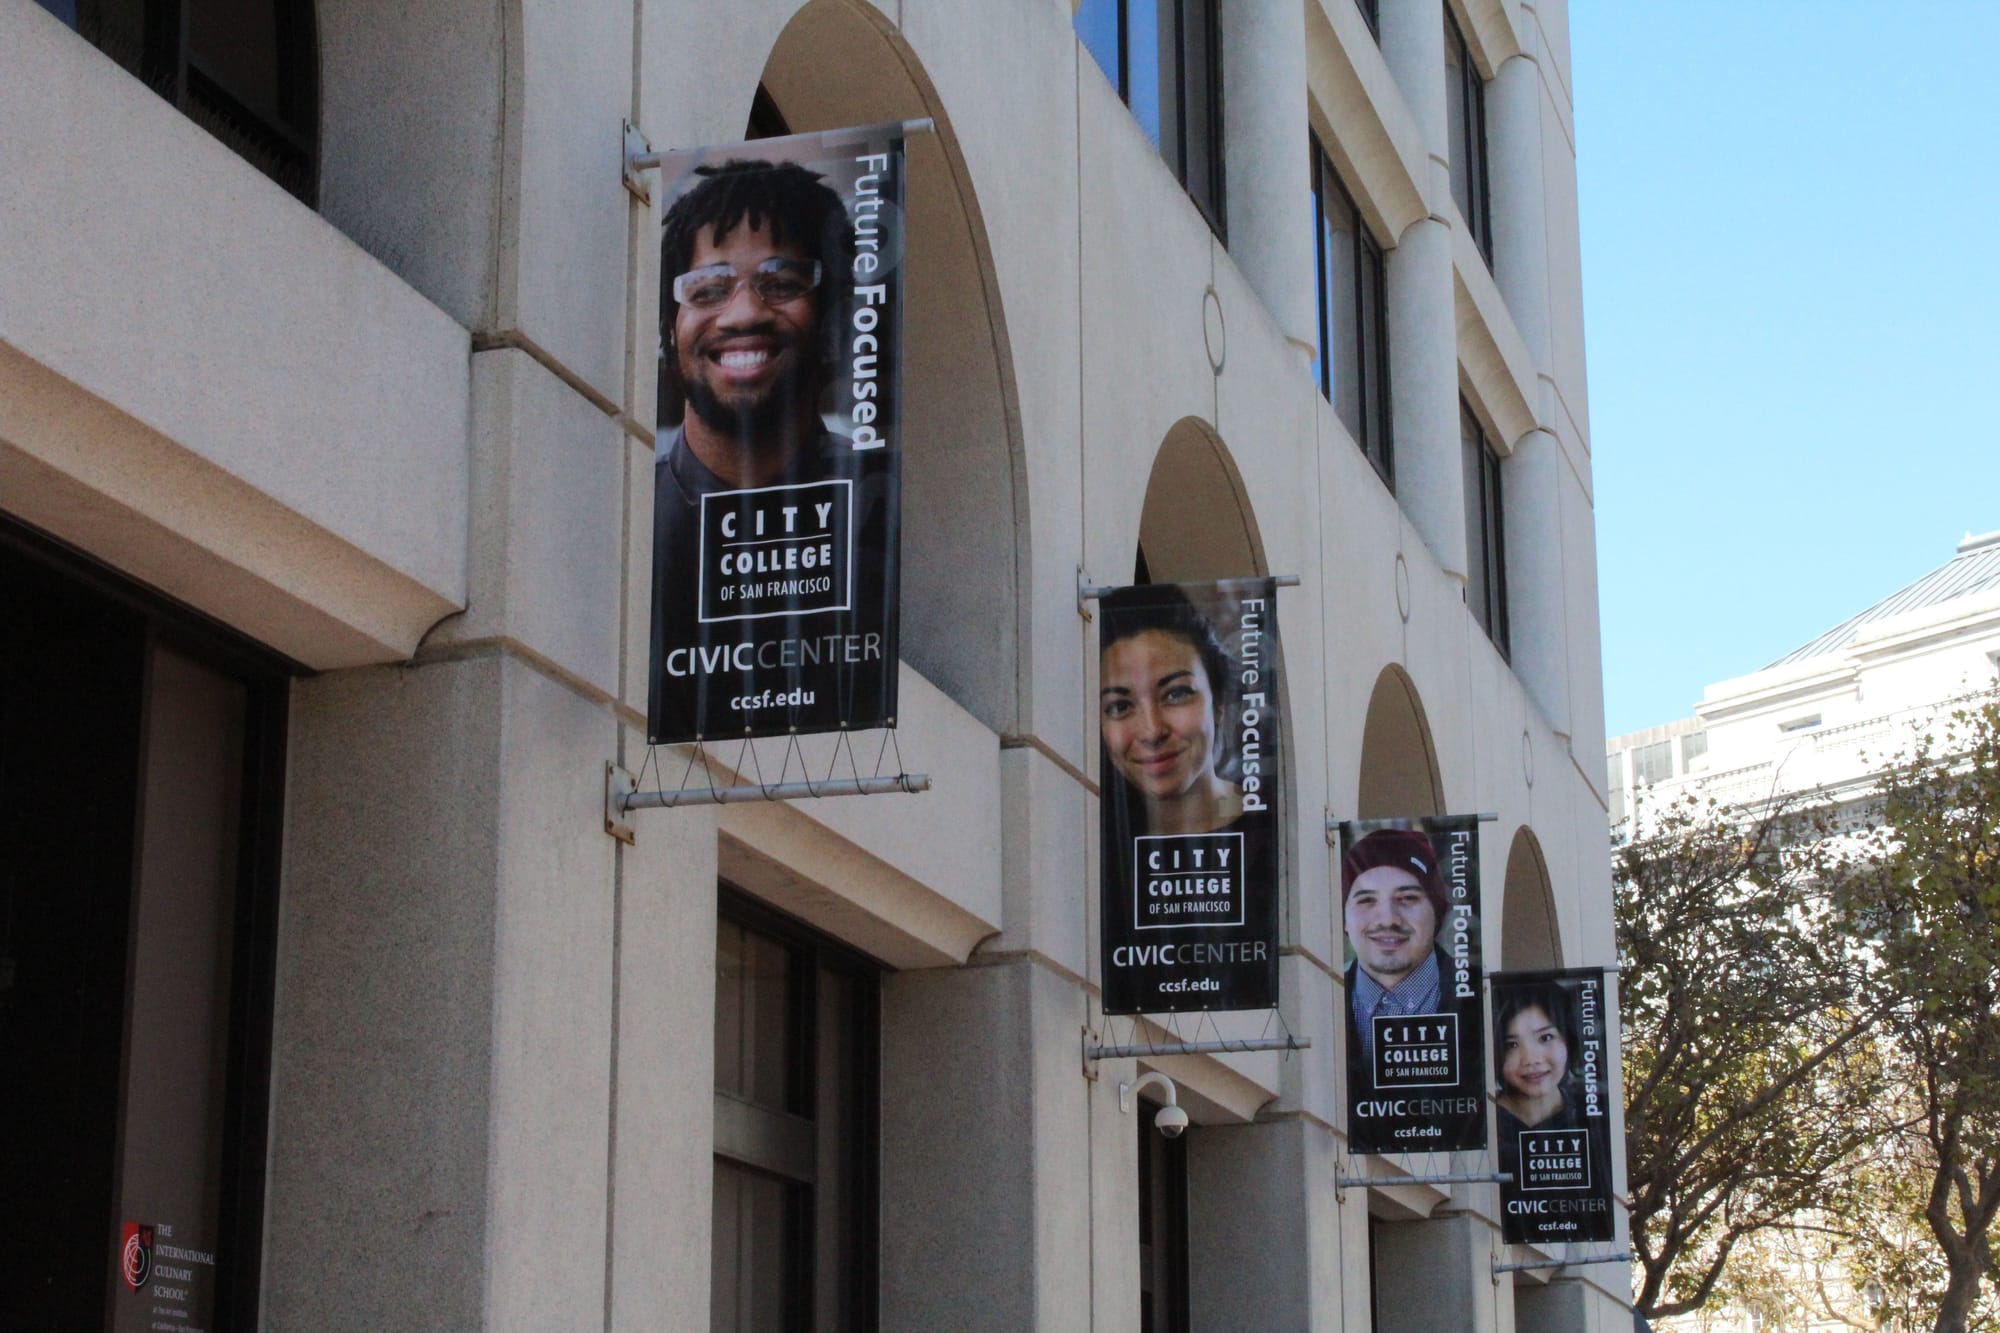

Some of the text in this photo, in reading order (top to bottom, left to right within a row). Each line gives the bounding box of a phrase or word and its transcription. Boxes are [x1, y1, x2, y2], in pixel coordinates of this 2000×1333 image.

[851, 153, 888, 450] Future Focused
[720, 502, 832, 538] CITY
[720, 543, 832, 575] COLLEGE
[720, 576, 831, 601] OF SAN FRANCISCO
[730, 687, 815, 710] ccsf.edu
[1240, 598, 1267, 812] Future Focused
[1148, 848, 1231, 870] CITY
[1148, 878, 1231, 896] COLLEGE
[1149, 901, 1231, 915] OF SAN FRANCISCO
[1450, 831, 1475, 998] Future Focused
[1158, 977, 1220, 993] ccsf.edu
[1383, 1025, 1448, 1043] CITY
[1384, 1048, 1449, 1063] COLLEGE
[1581, 979, 1603, 1117] Future Focused
[1385, 1066, 1449, 1078] OF SAN FRANCISCO
[1394, 1125, 1442, 1138] ccsf.edu
[1528, 1138, 1581, 1153] CITY
[1529, 1158, 1582, 1170] COLLEGE
[158, 1223, 172, 1236] THE
[1538, 1221, 1578, 1231] ccsf.edu
[156, 1244, 215, 1265] INTERNATIONAL
[154, 1265, 193, 1281] CULINARY
